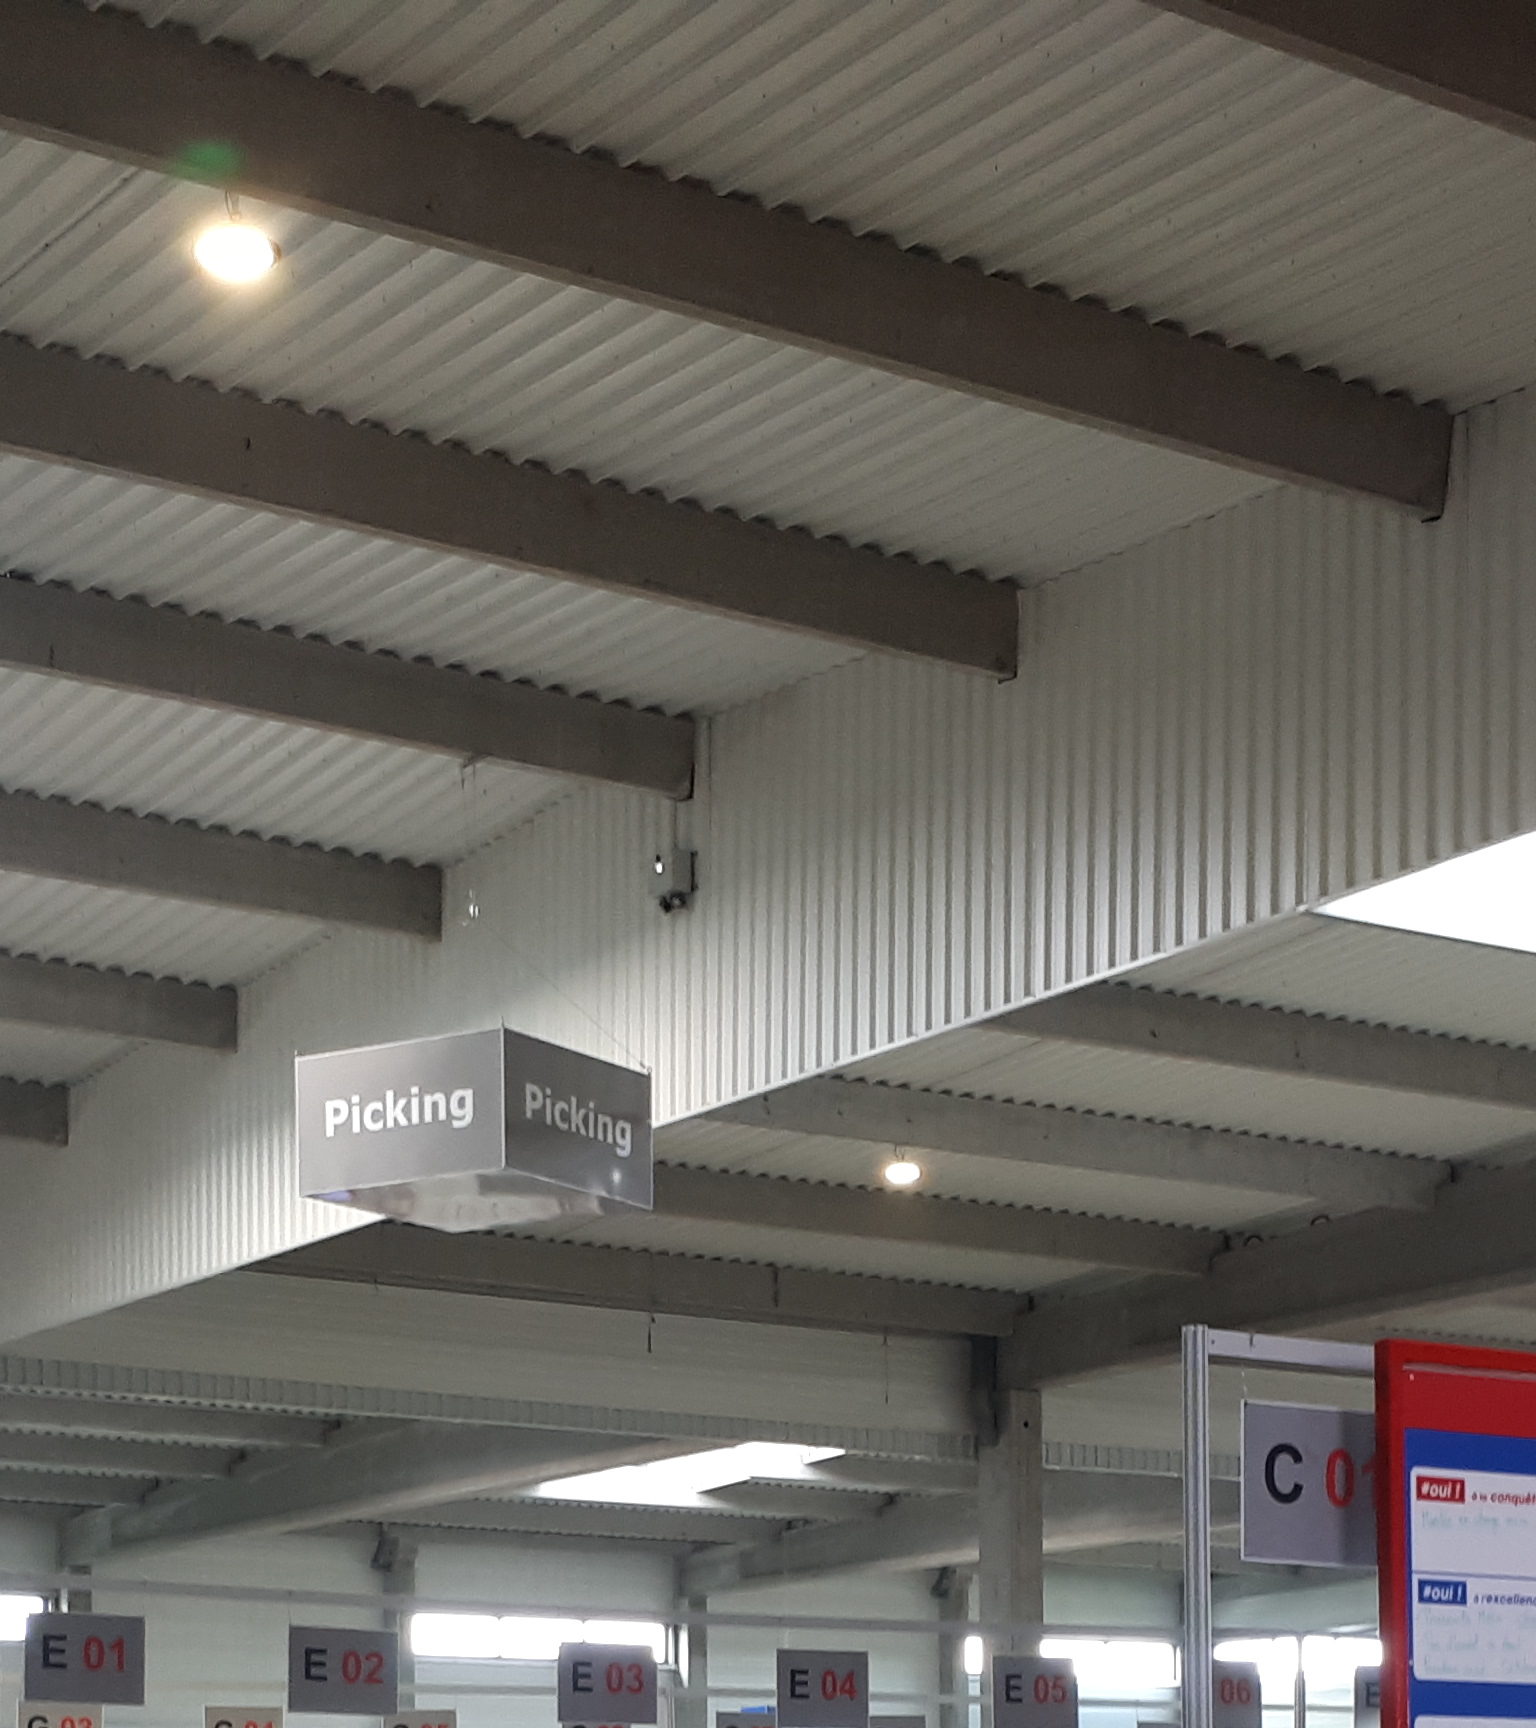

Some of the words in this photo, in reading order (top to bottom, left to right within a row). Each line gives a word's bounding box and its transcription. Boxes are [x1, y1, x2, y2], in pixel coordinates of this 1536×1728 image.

[324, 1086, 474, 1138] Picking
[524, 1082, 633, 1158] Picking
[1264, 1442, 1304, 1505] C
[1420, 1481, 1452, 1499] #oui
[1423, 1584, 1454, 1601] #oui
[42, 1634, 68, 1669] E
[83, 1636, 126, 1673] 01
[304, 1646, 328, 1682] E
[341, 1652, 385, 1684] 02
[572, 1661, 593, 1693] E
[606, 1662, 645, 1695] 03
[790, 1669, 810, 1699] E
[821, 1669, 858, 1700] 04
[1004, 1674, 1023, 1704] E
[1033, 1674, 1068, 1704] 05
[1220, 1677, 1251, 1706] 06
